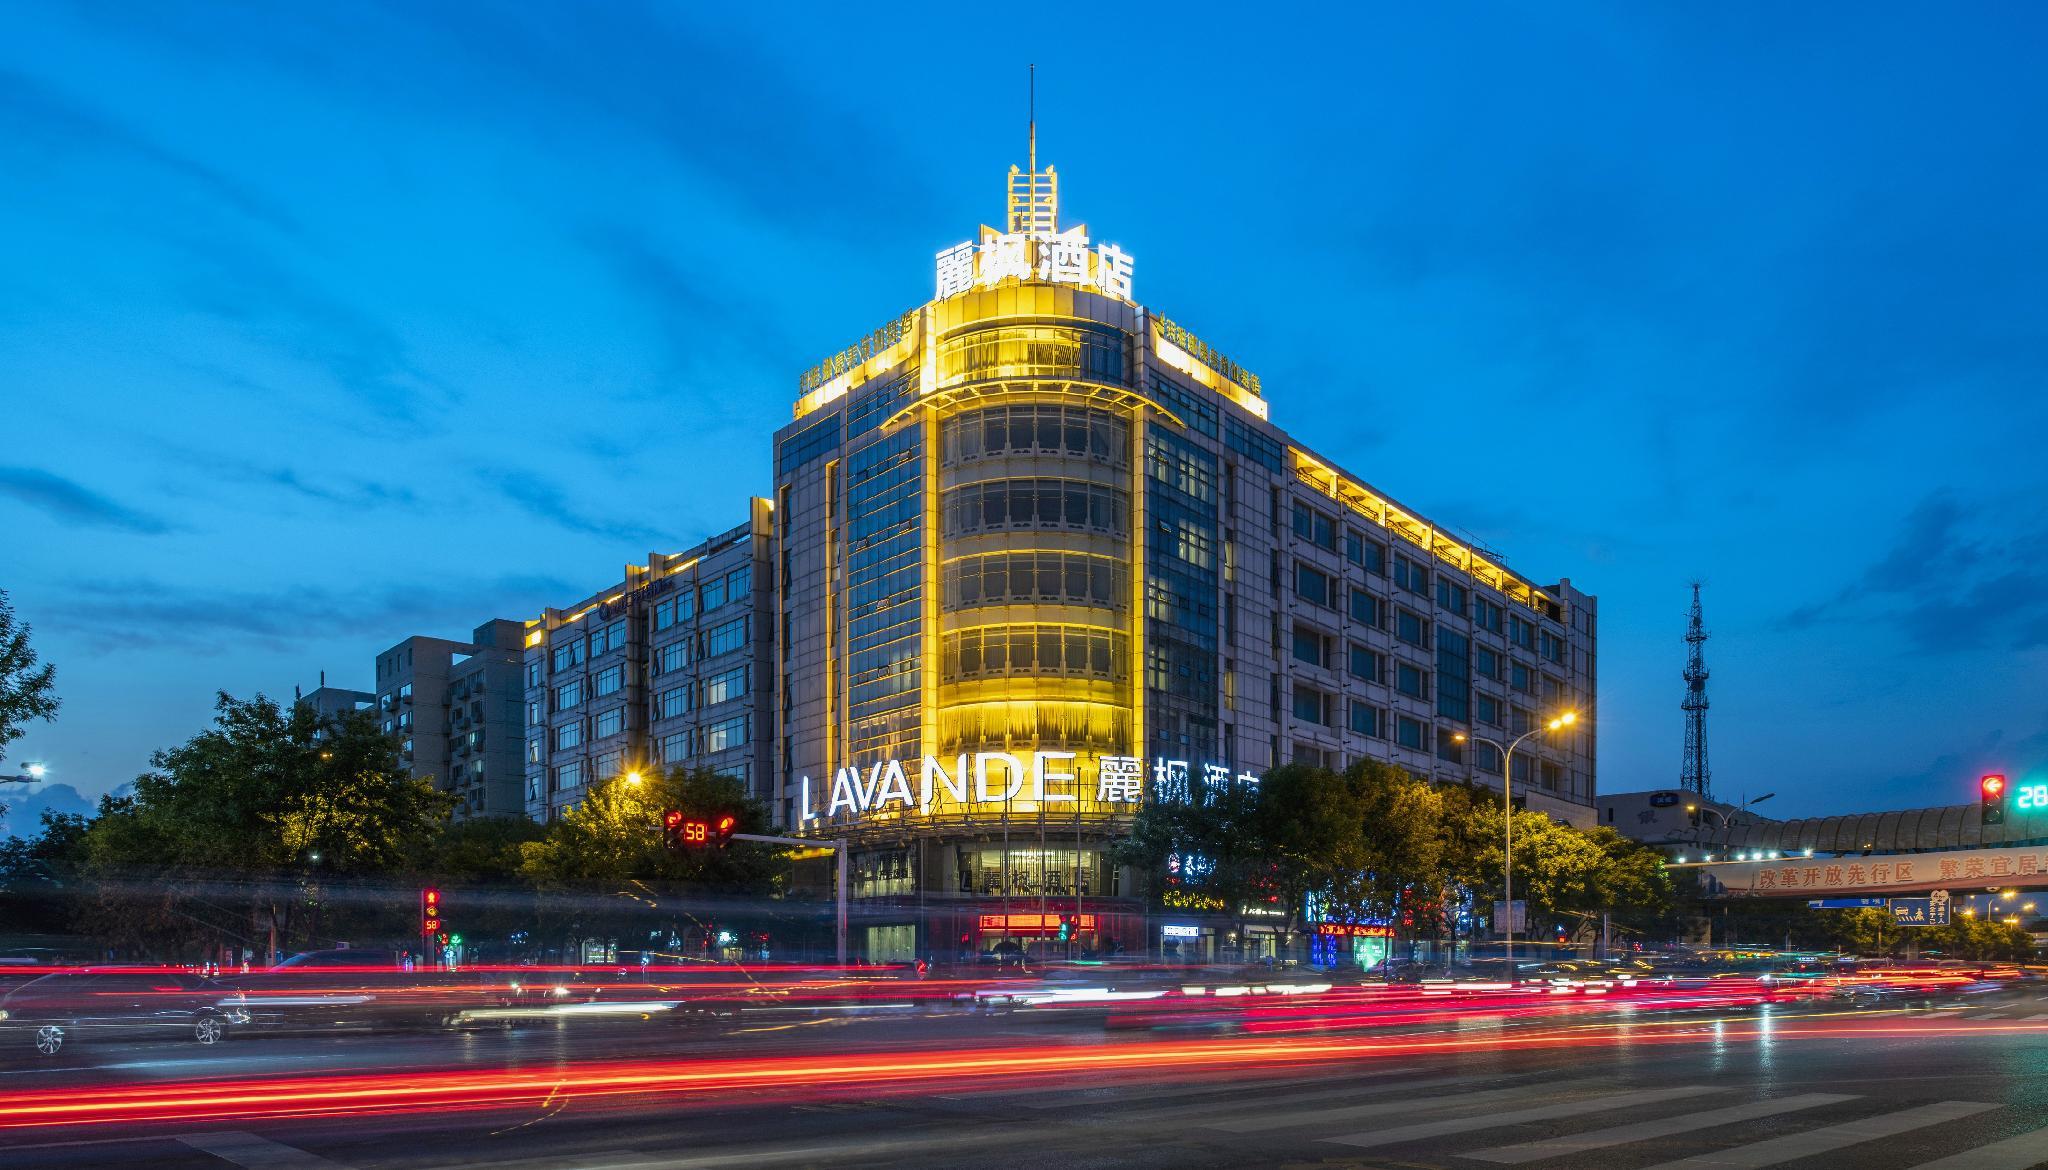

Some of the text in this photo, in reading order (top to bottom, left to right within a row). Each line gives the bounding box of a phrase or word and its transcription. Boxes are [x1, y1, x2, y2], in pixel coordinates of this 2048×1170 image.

[802, 752, 1077, 820] LAVANDE
[2018, 785, 2048, 808] 28
[686, 823, 705, 841] 58
[1760, 854, 2048, 888] 改革开放先行区 繁荣宜居
[426, 920, 437, 930] 58
